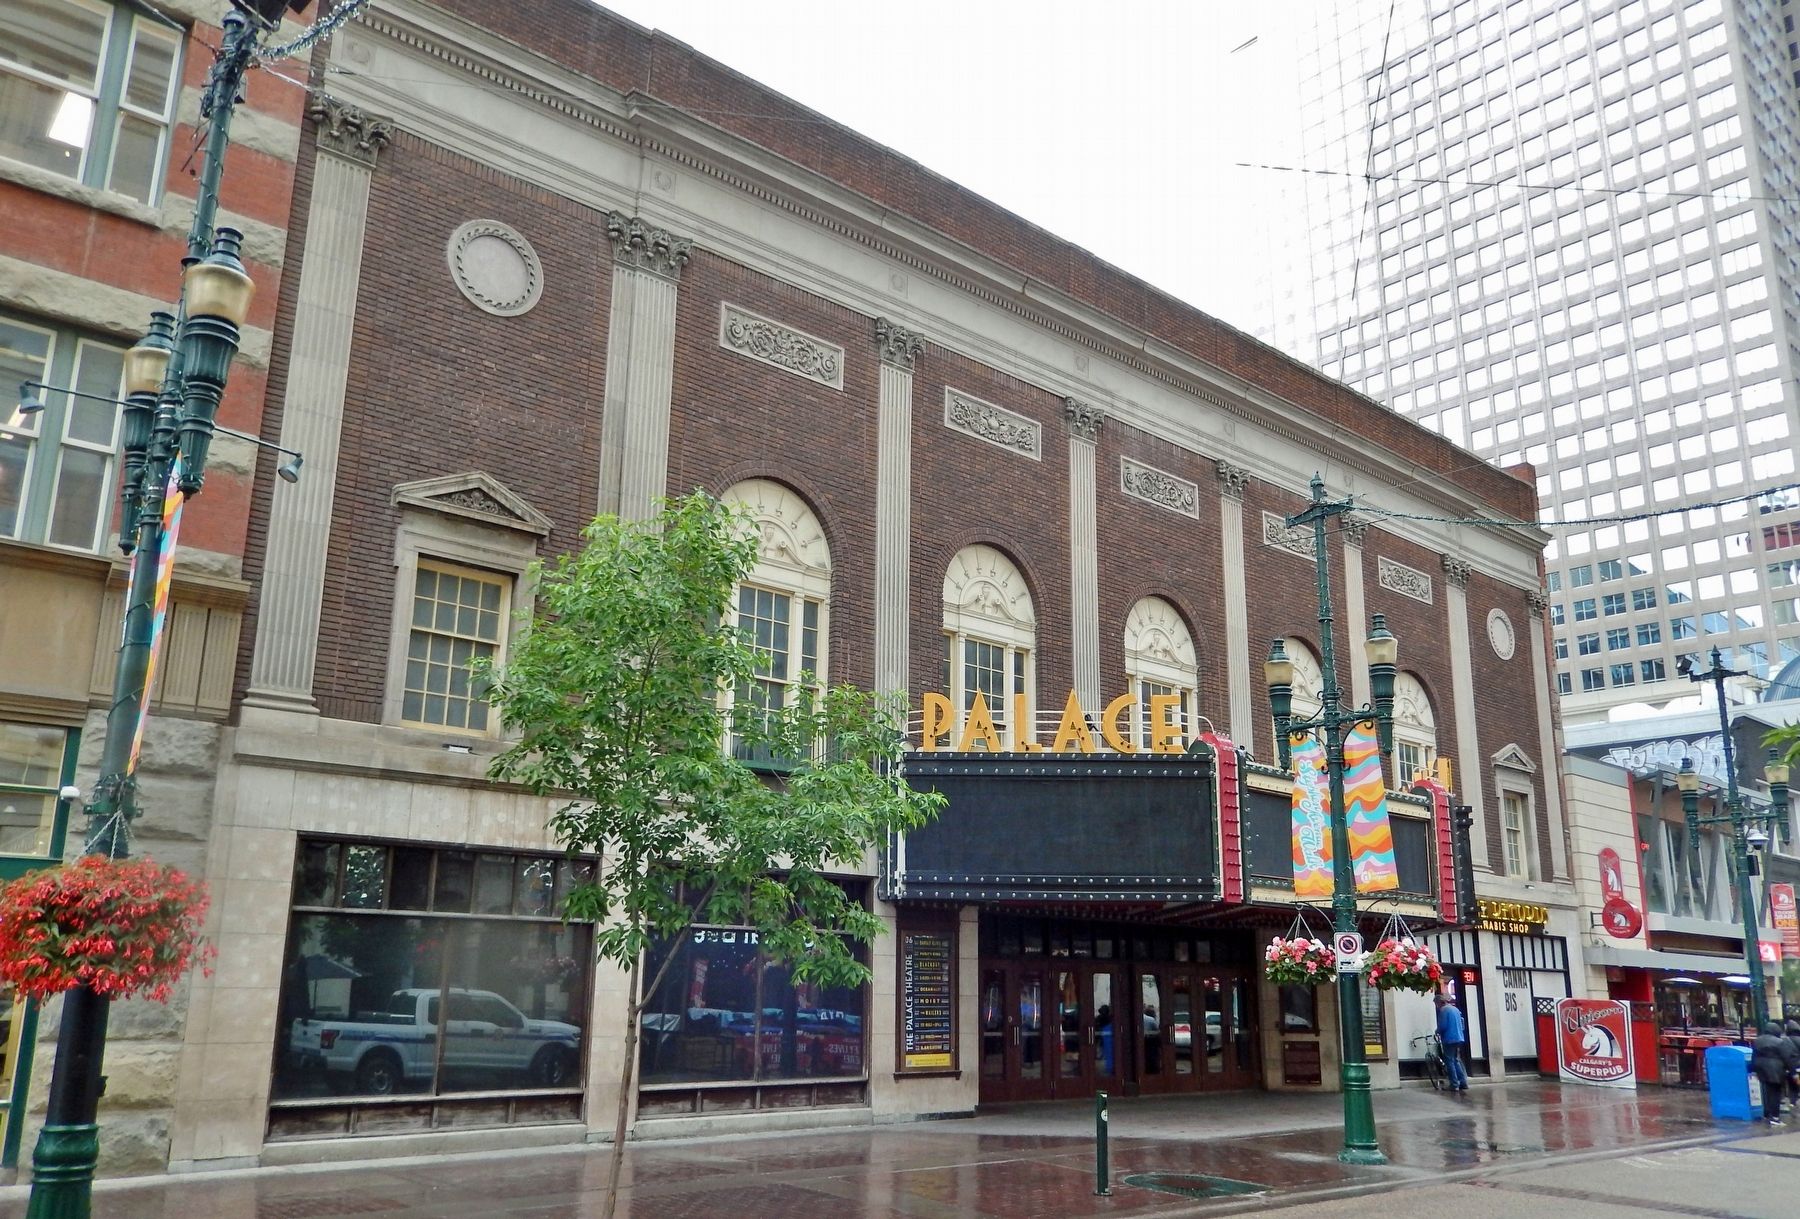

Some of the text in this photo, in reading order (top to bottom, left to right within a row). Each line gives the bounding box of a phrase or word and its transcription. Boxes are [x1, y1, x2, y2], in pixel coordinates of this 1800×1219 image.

[924, 688, 1185, 755] PALACE
[1509, 923, 1530, 934] SHOP
[1502, 970, 1528, 989] CANNA
[905, 954, 914, 1051] THE PALACE THEATRE
[1504, 992, 1518, 1012] BIS
[1570, 1063, 1624, 1077] SUPERPUB
[1579, 1057, 1613, 1066] CALGARY'S
